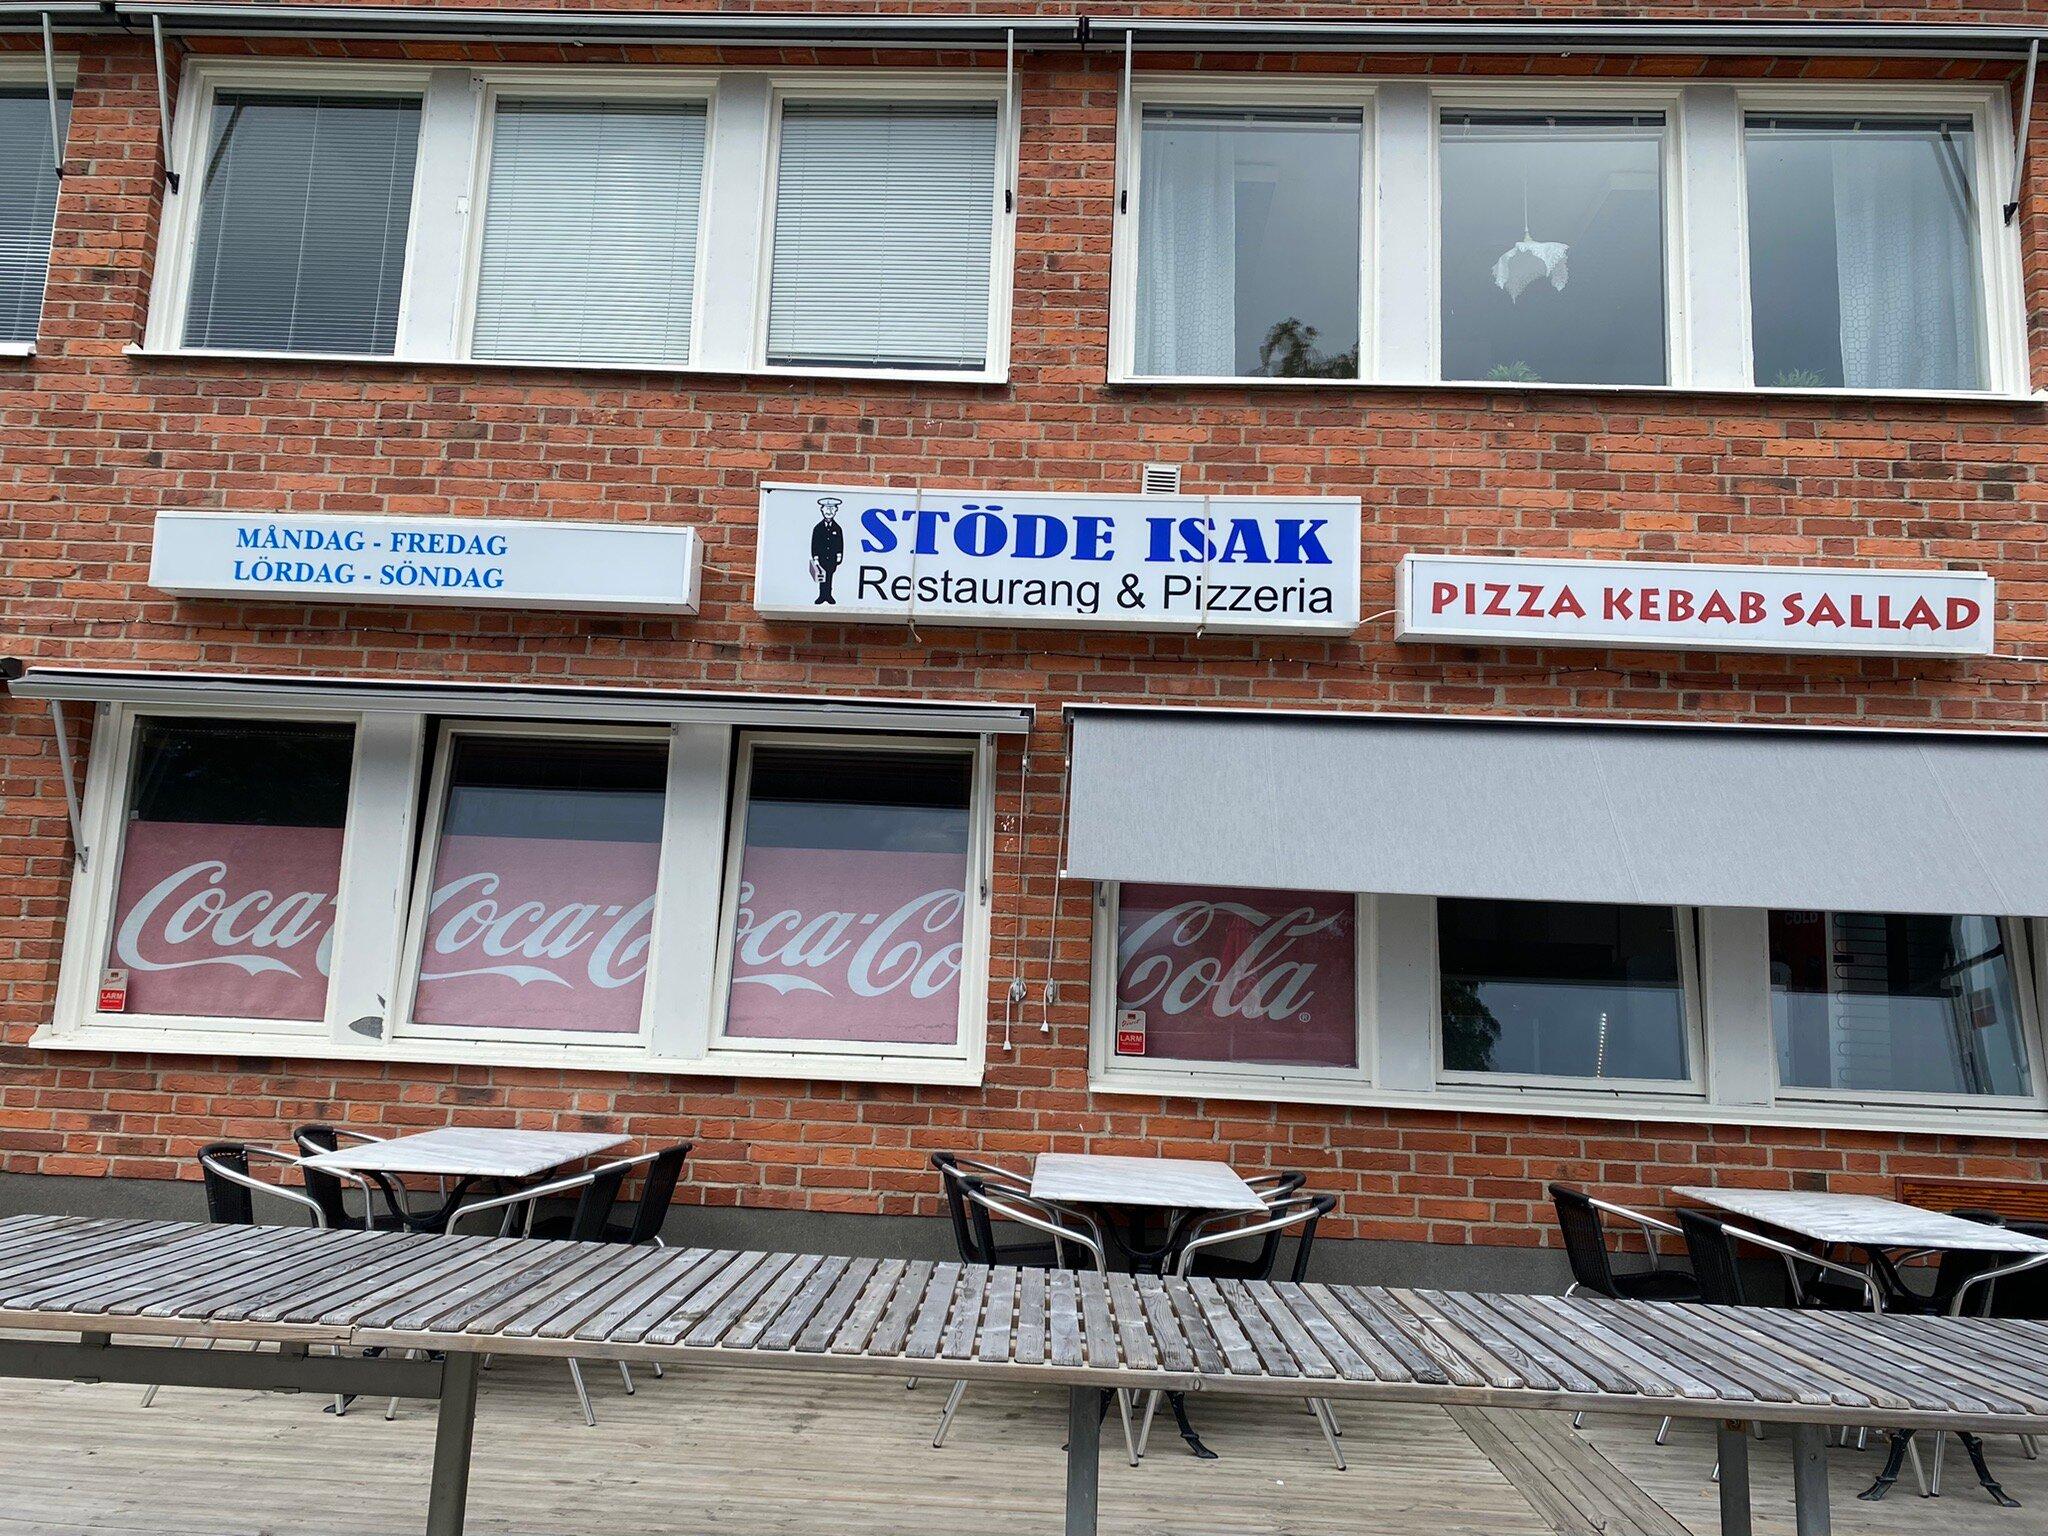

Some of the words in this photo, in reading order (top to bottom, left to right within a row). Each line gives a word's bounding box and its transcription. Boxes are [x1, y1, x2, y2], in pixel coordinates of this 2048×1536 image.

[236, 525, 366, 553] MÅNDAG
[390, 532, 508, 557] FREDAG
[860, 504, 1116, 562] STÖDE
[1145, 516, 1334, 565] ISAK
[233, 556, 356, 585] LÖRDAG
[380, 560, 505, 589] SÖNDAG
[859, 566, 1101, 614] Restaurang
[1117, 574, 1146, 610] &
[1164, 575, 1334, 614] Pizzeria
[1432, 582, 1586, 618] PIZZA
[1603, 588, 1767, 624] KEBAB
[1783, 593, 1981, 631] SALLAD
[1118, 900, 1346, 1021] Cola
[101, 992, 123, 1000] LARM
[1119, 1034, 1143, 1043] LARM
